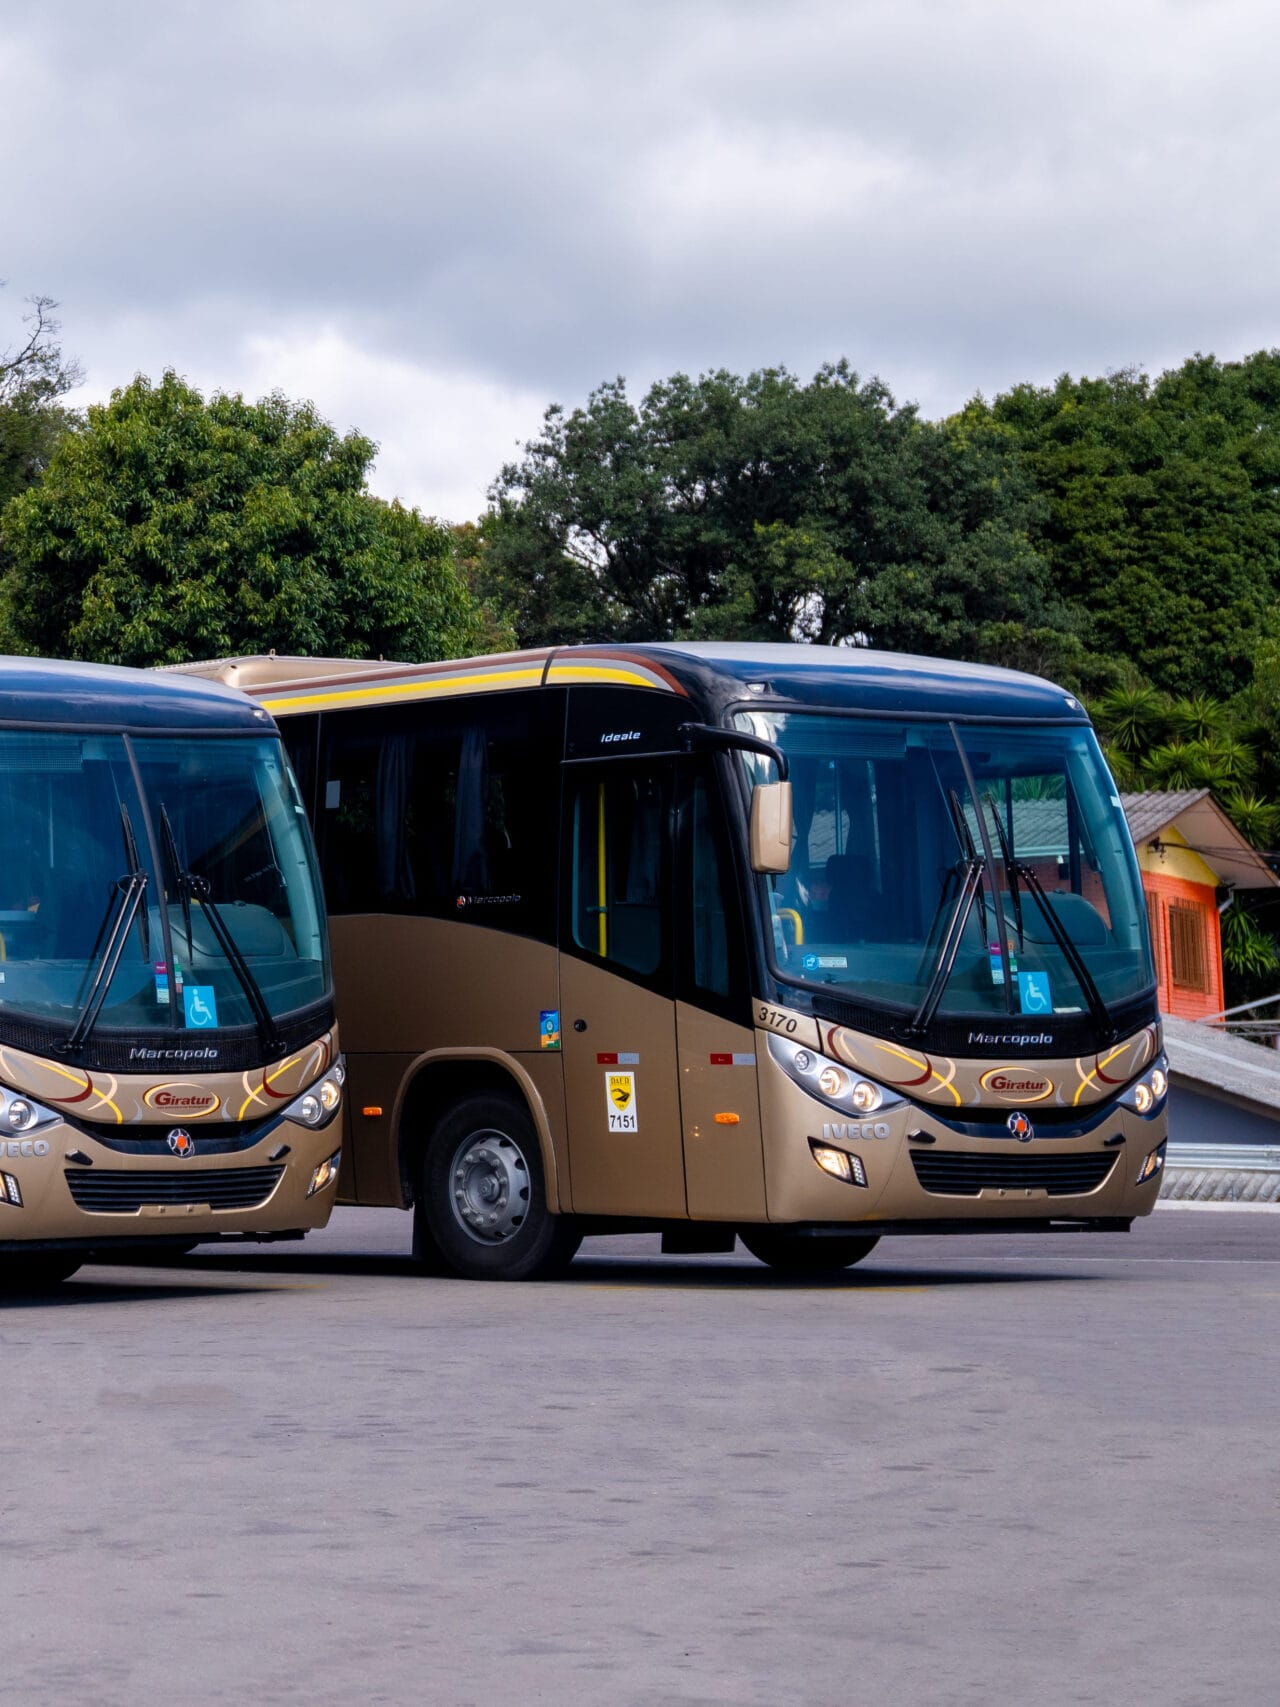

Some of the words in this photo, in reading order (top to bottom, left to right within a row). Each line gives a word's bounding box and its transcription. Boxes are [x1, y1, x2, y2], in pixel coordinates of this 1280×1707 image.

[600, 731, 641, 743] Ideale
[758, 1006, 798, 1033] 3170
[967, 1032, 1054, 1046] Marcopolo
[129, 1047, 219, 1060] Marcopolo
[990, 1076, 1046, 1090] Giratur
[154, 1091, 212, 1106] Giratur
[609, 1114, 635, 1128] 7151
[823, 1122, 890, 1139] IVECO
